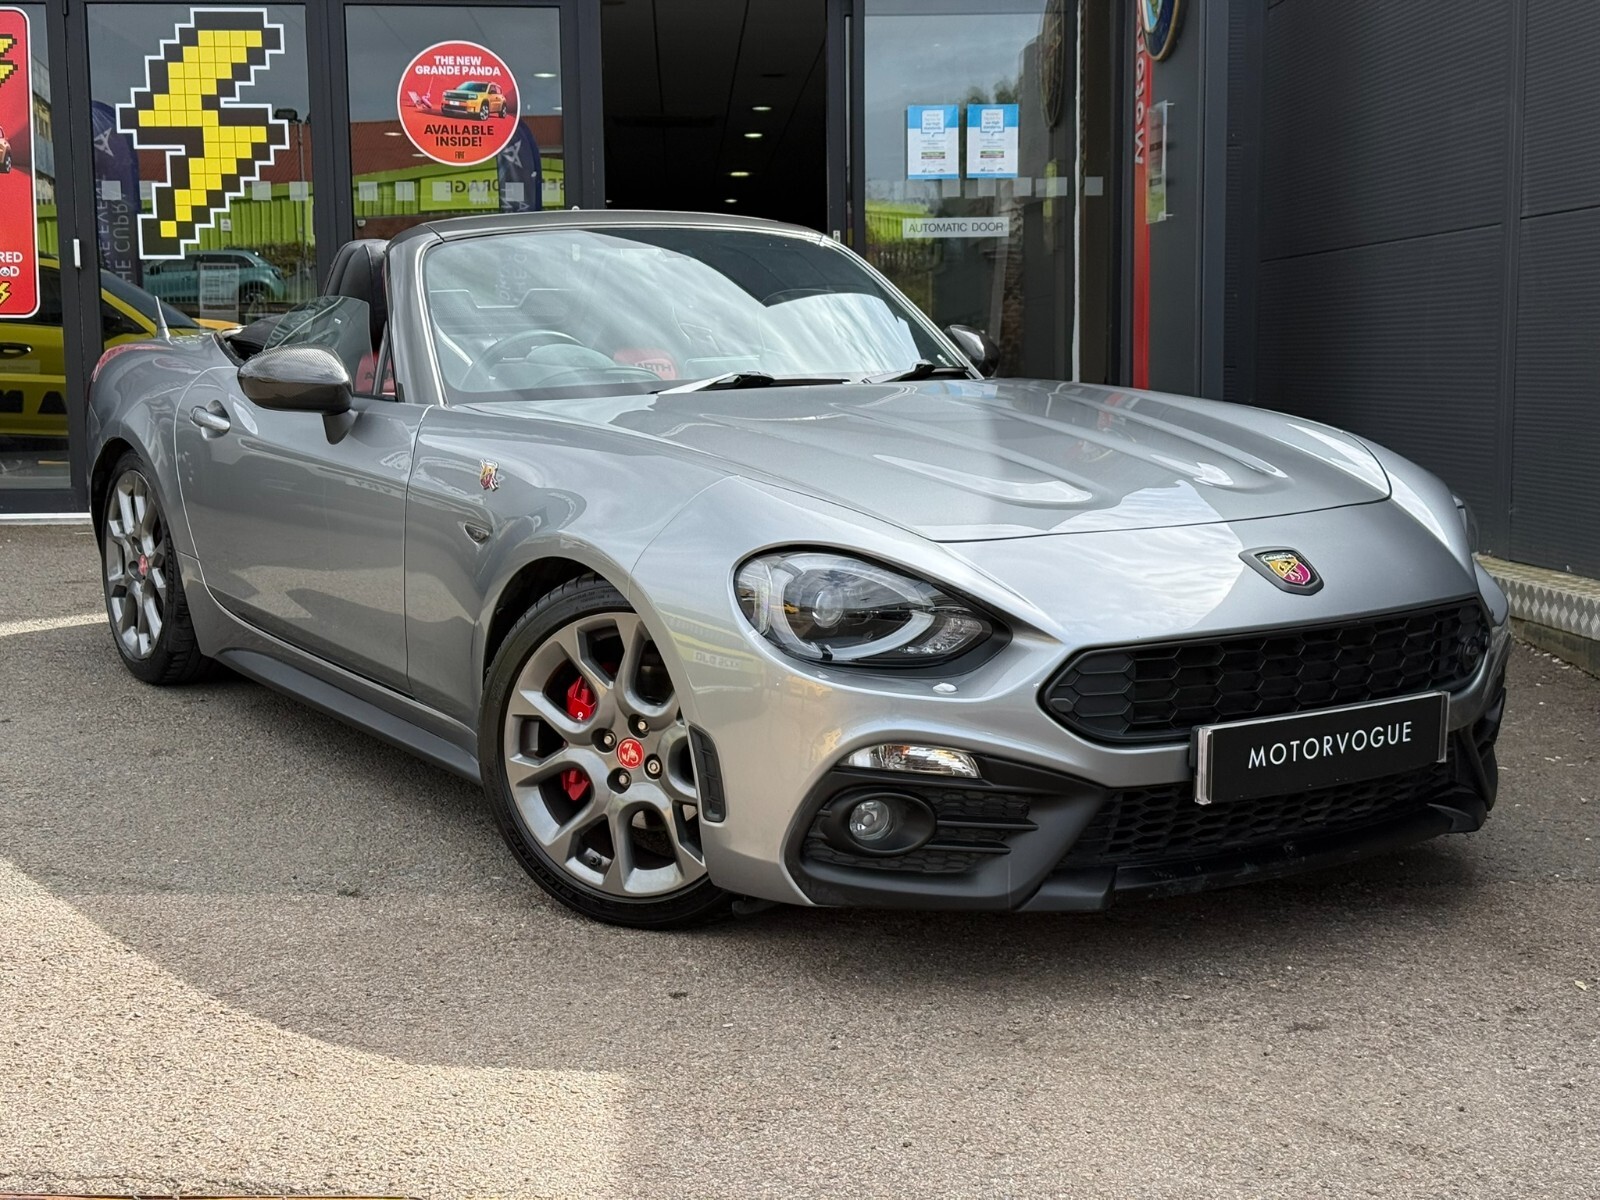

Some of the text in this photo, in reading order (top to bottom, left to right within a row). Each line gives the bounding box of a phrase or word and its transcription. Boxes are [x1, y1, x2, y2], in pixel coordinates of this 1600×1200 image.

[434, 55, 482, 65] THE NEW
[415, 65, 502, 76] GRANDE PANDA
[424, 124, 494, 136] AVAILABLE
[435, 136, 482, 147] INSIDE!
[908, 222, 1004, 233] AUTOMATIC DOOR
[0, 251, 23, 263] RED
[1248, 720, 1413, 770] MOTORVOGUE
